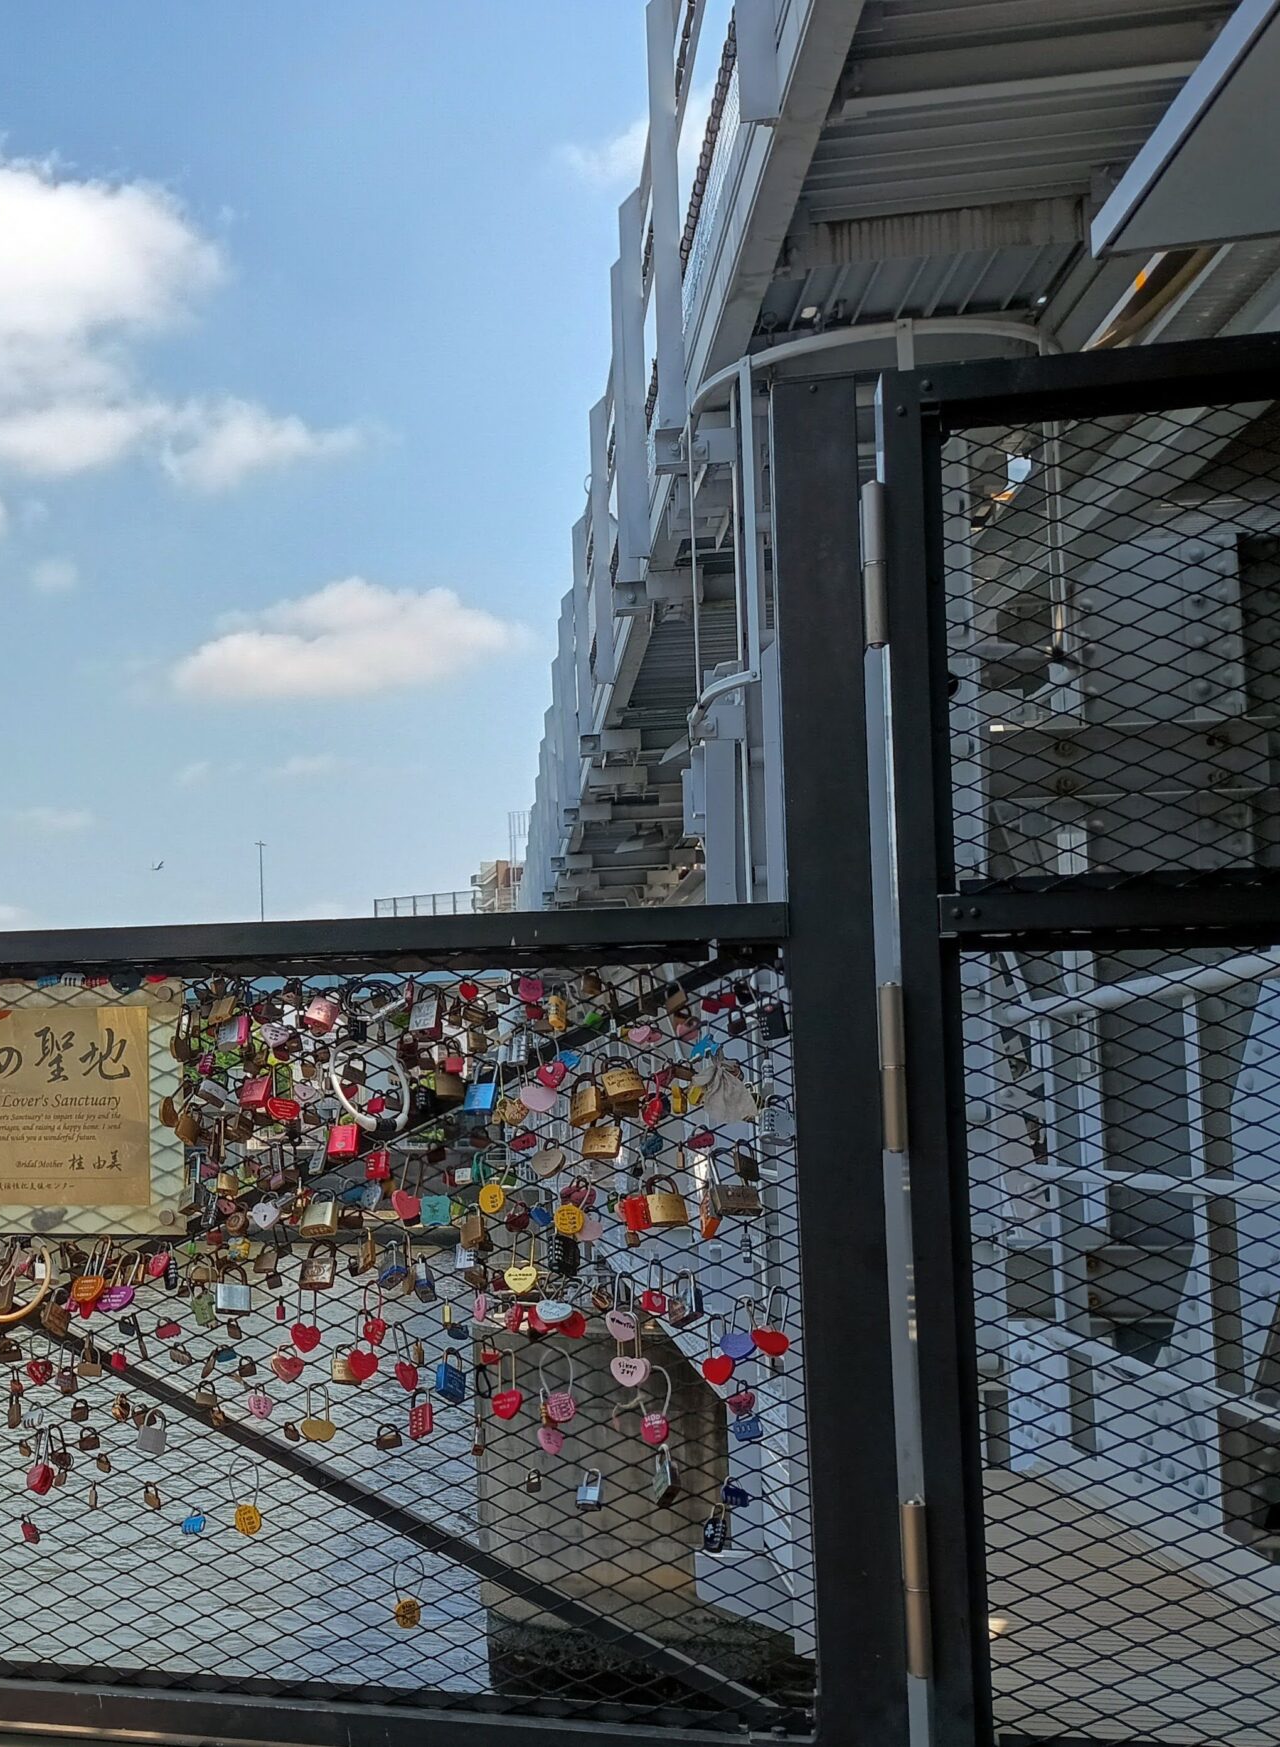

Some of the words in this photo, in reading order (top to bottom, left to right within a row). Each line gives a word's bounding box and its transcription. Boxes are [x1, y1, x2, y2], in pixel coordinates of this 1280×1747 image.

[0, 1094, 49, 1108] Lover's
[51, 1094, 121, 1110] Sanctuary
[15, 1159, 38, 1168] Bridal
[38, 1160, 64, 1168] Mother
